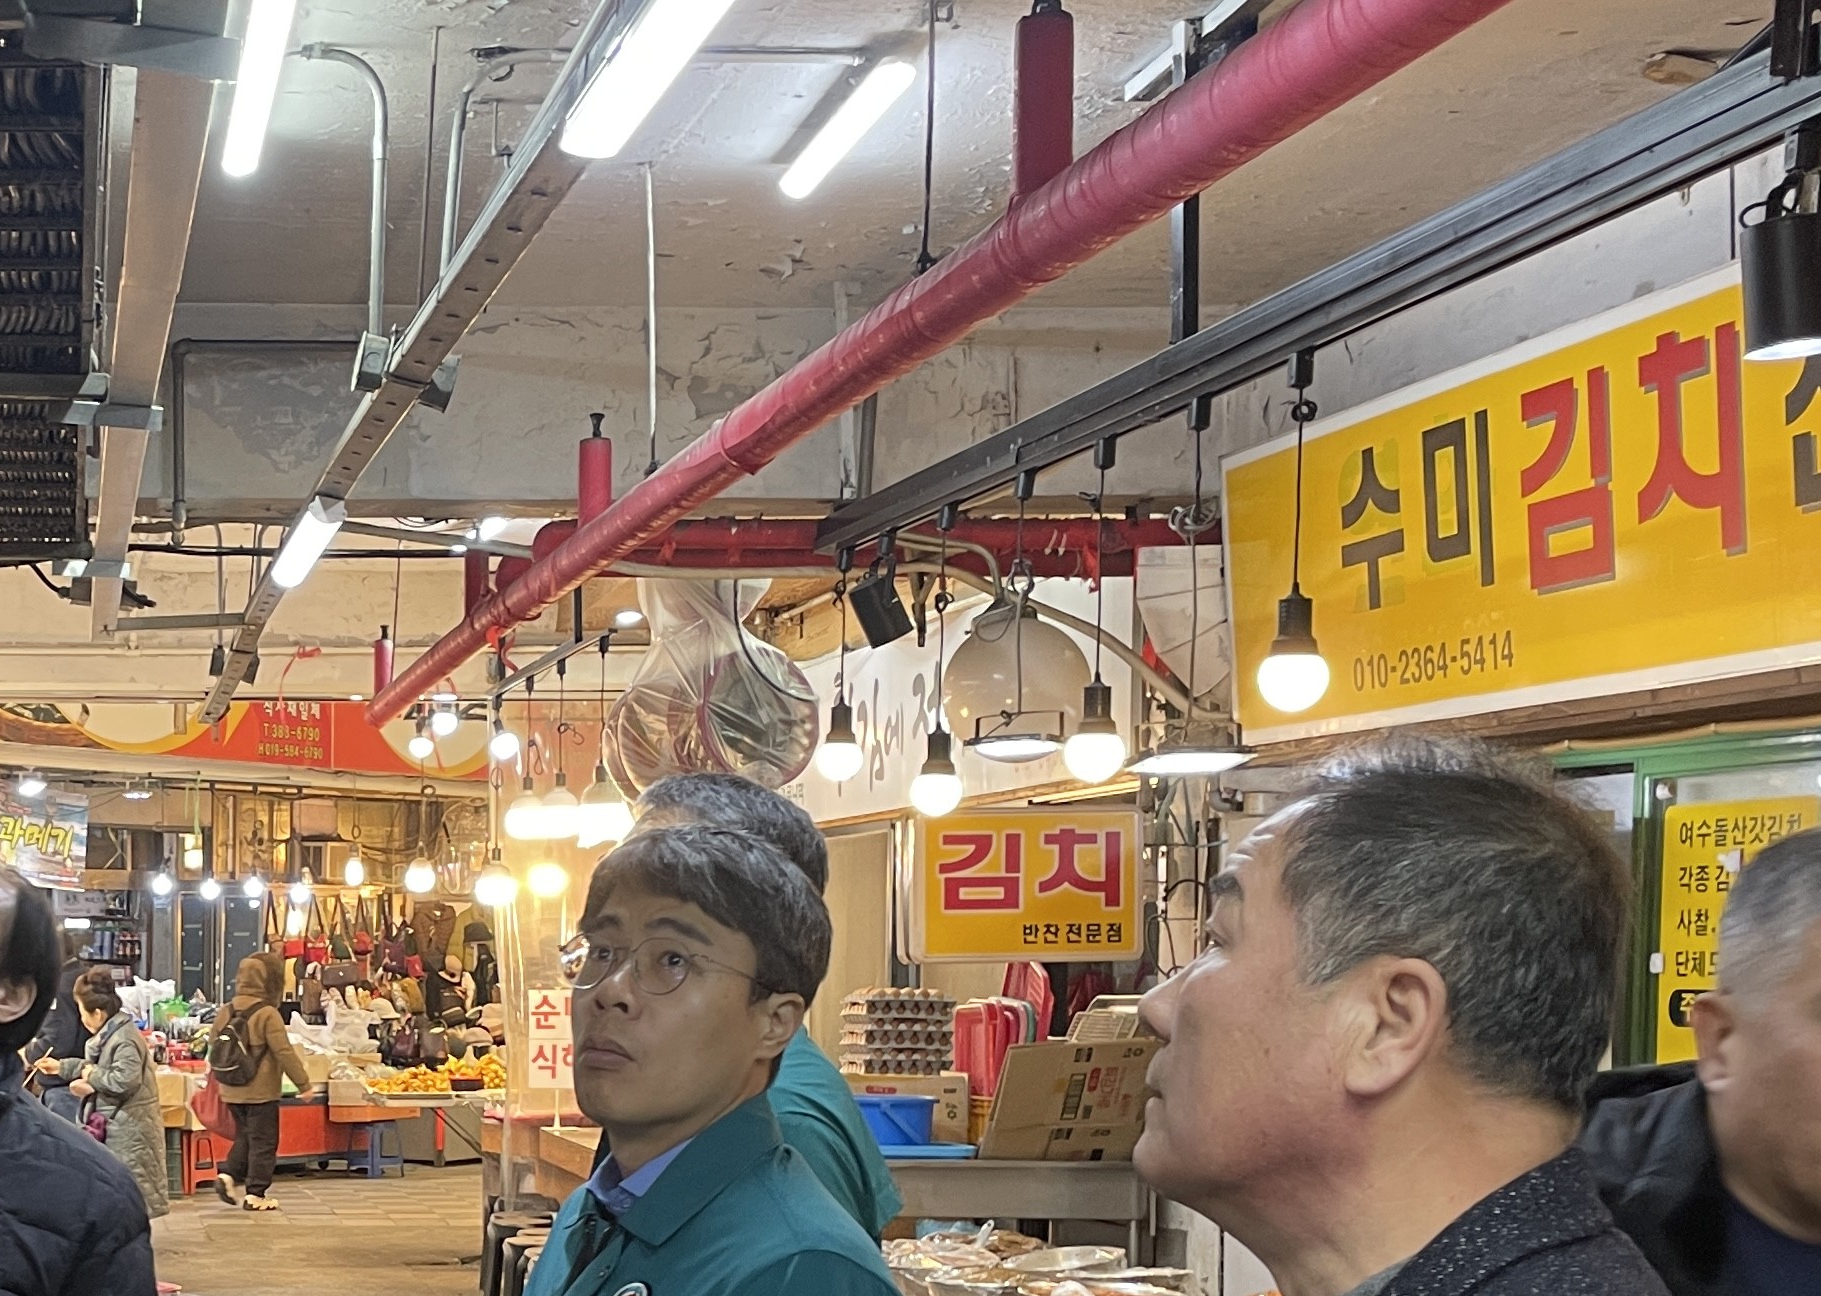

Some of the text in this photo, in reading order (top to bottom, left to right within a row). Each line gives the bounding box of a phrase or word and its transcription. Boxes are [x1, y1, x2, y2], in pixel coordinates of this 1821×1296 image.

[1352, 629, 1515, 692] 010-2364-5414
[937, 827, 1122, 912] 김치
[1678, 865, 1710, 893] 각종
